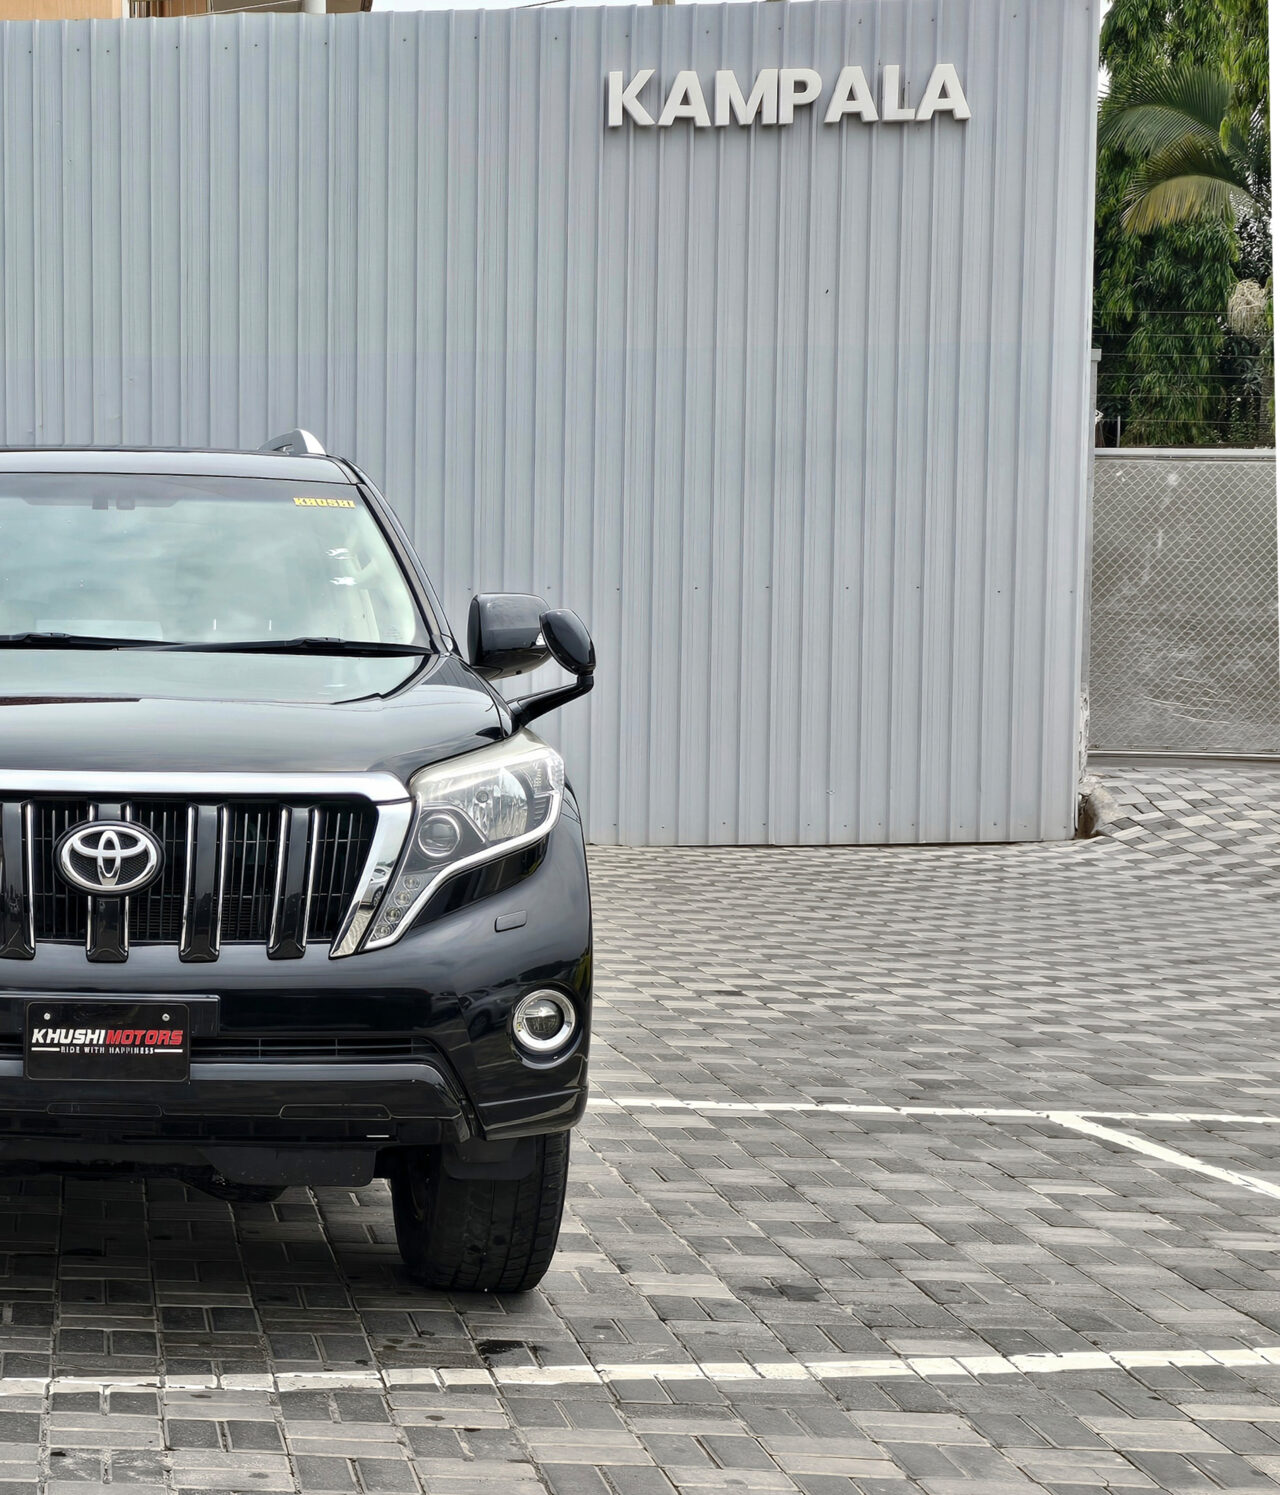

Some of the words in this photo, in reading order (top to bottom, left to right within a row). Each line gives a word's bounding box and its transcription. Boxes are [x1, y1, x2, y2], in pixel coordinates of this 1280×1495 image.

[608, 63, 972, 127] KAMPALA
[293, 497, 355, 509] KHUSHI
[31, 1028, 106, 1045] KHUSHI
[105, 1029, 184, 1046] MOTORS
[60, 1045, 80, 1054] RIDE
[84, 1046, 105, 1054] WITH
[109, 1046, 154, 1055] HAPPINESS
